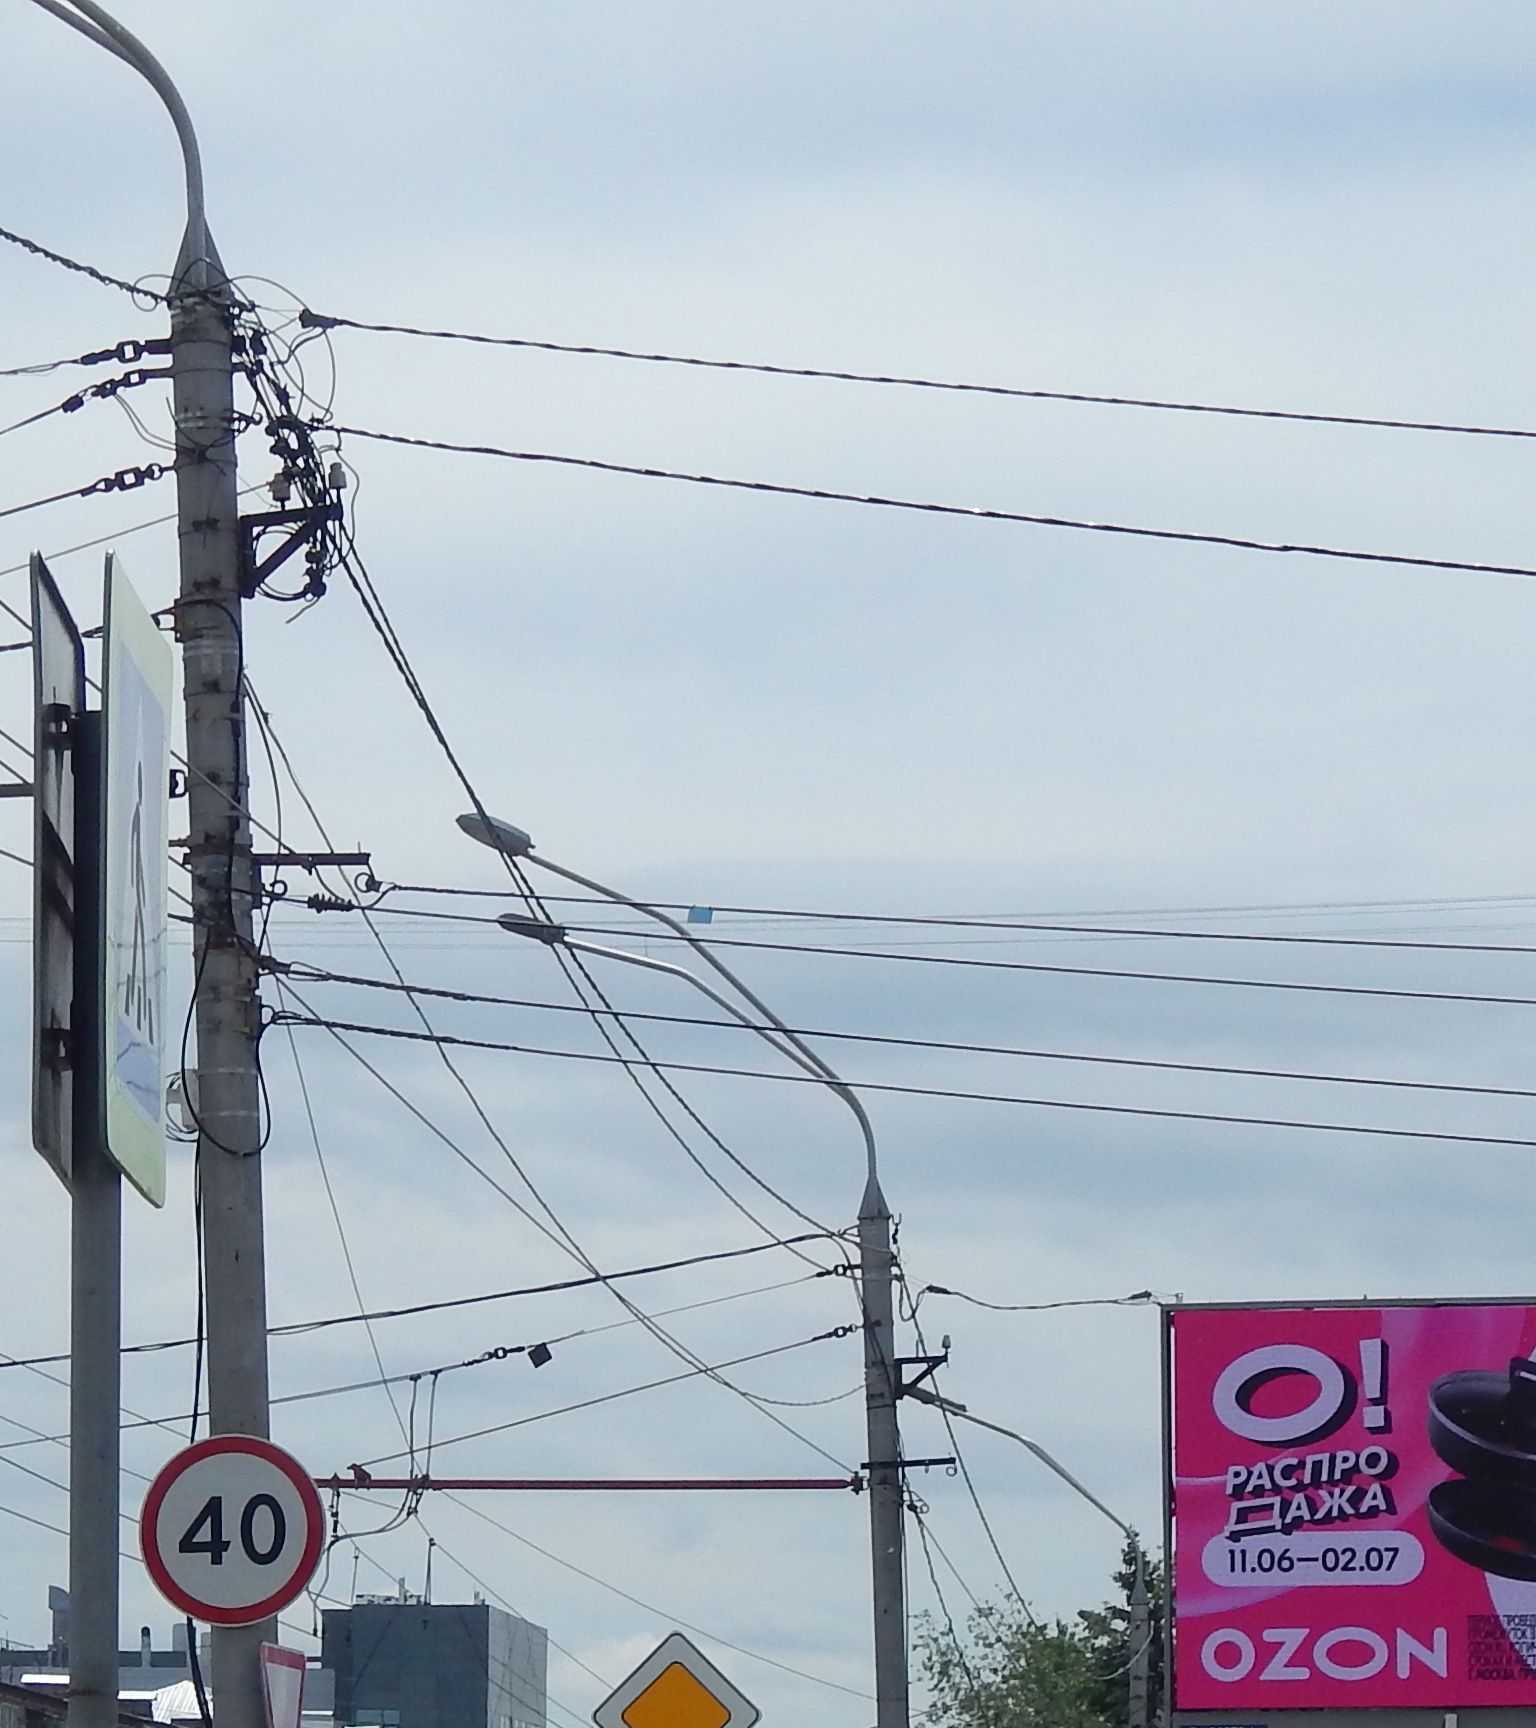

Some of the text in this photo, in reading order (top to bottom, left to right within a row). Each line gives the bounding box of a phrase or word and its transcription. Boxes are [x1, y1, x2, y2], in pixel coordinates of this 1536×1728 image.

[1224, 1446, 1390, 1496] РАСПРО
[177, 1492, 287, 1567] 40
[1223, 1482, 1390, 1535] ДАЖА
[1201, 1626, 1448, 1683] OZON
